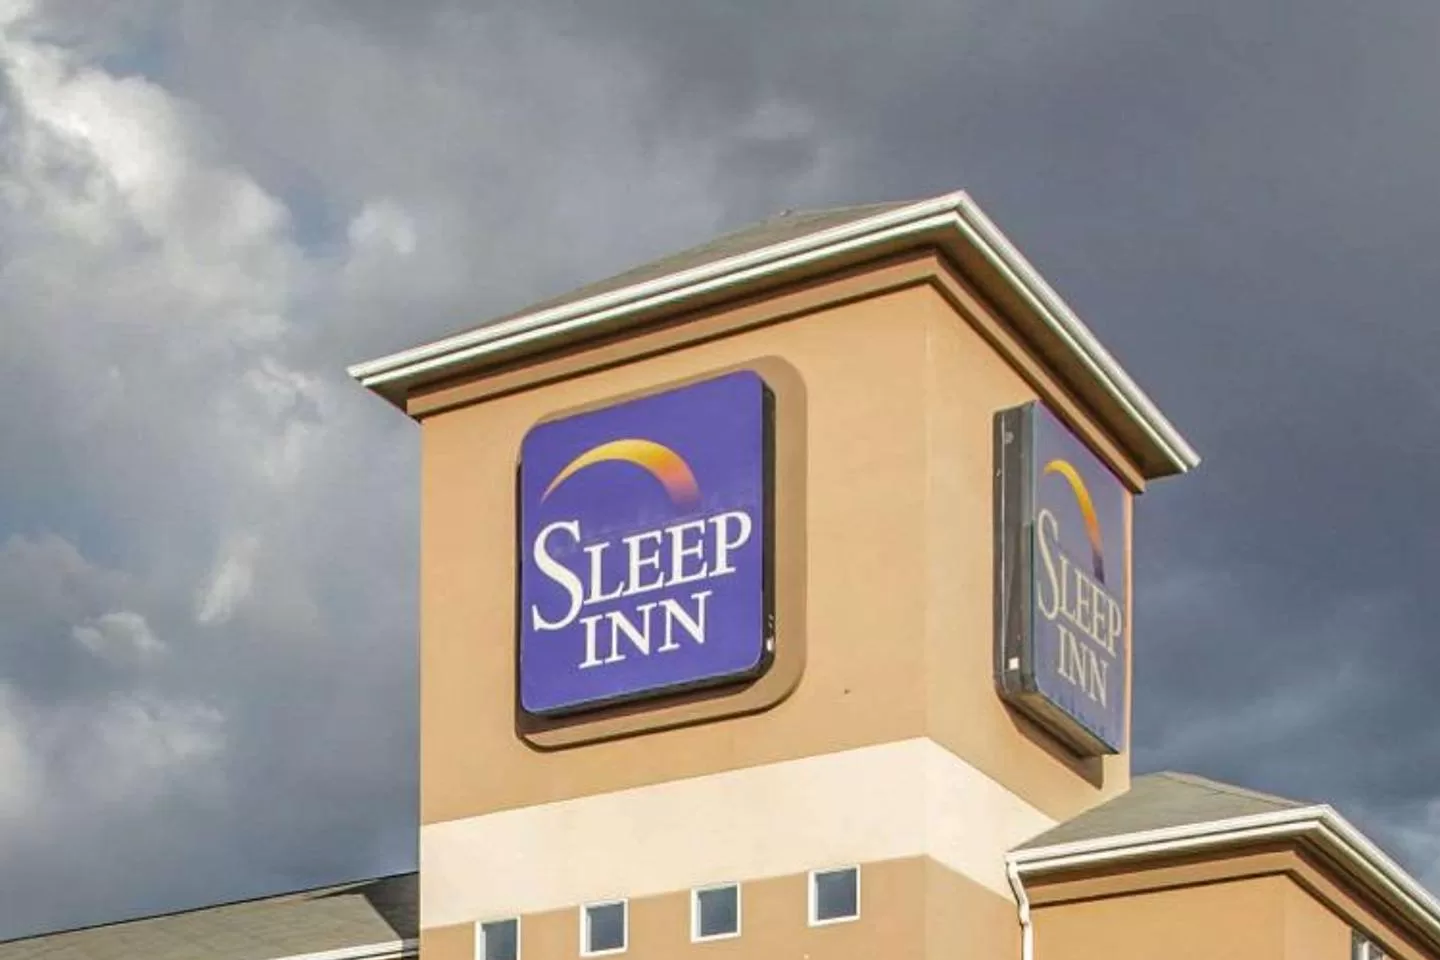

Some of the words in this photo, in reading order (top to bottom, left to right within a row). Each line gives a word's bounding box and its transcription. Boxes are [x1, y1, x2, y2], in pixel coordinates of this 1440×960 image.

[531, 510, 752, 632] SLEEP
[1037, 507, 1123, 658] SLEEP
[578, 590, 713, 669] INN
[1057, 623, 1109, 708] INN
